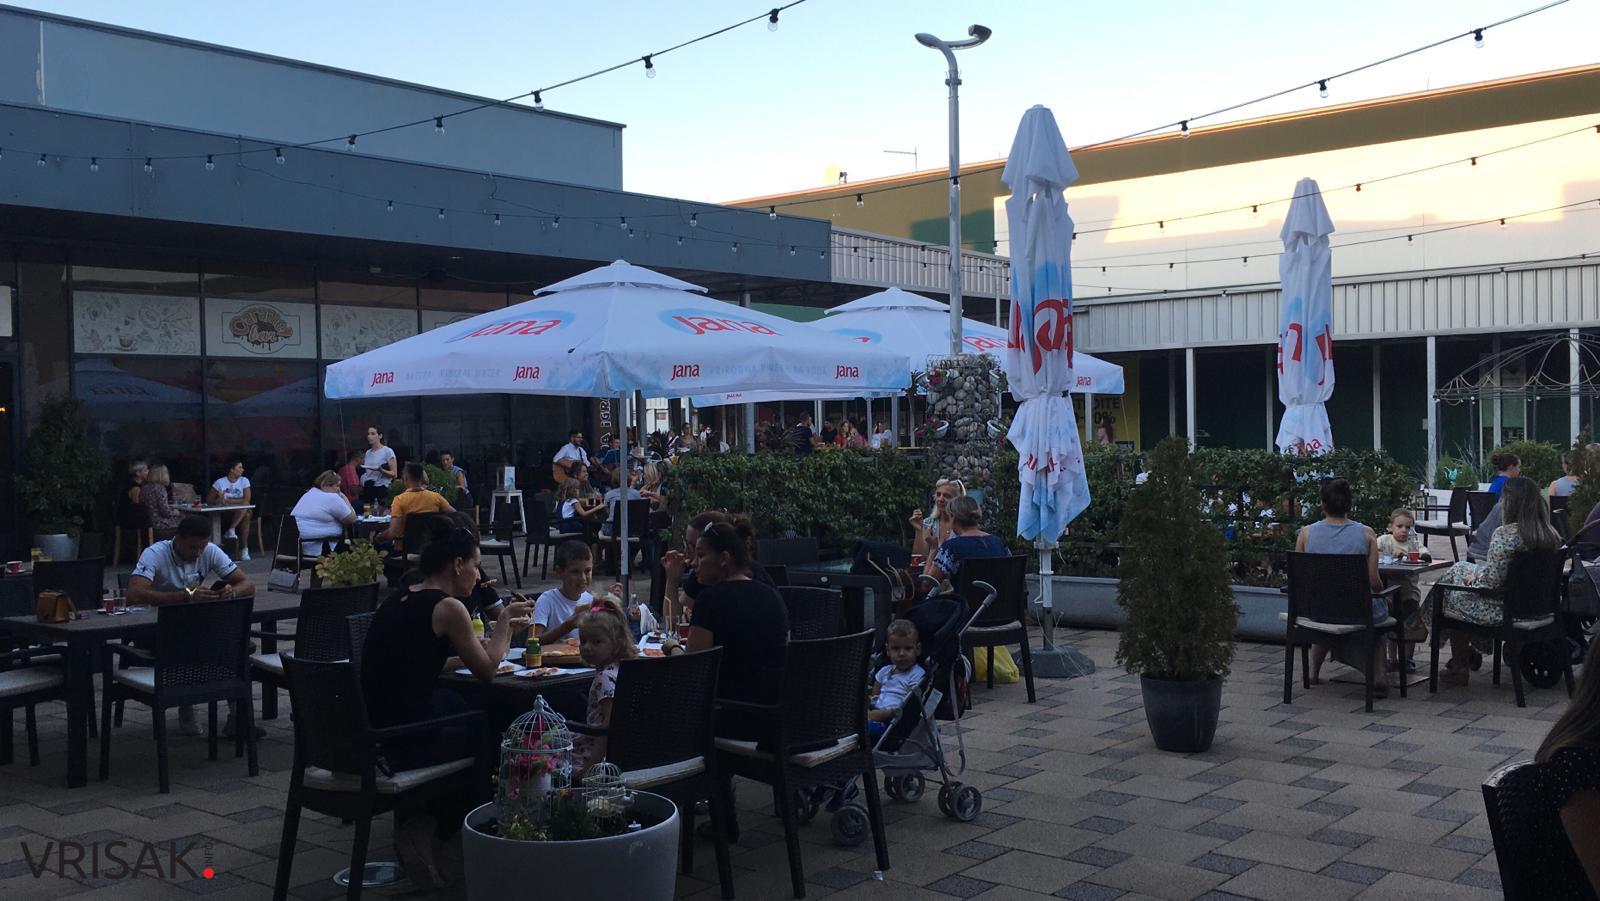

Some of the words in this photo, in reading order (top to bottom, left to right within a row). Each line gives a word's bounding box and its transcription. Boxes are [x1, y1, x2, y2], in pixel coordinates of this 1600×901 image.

[371, 371, 395, 387] Jana
[512, 365, 540, 382] Jana
[670, 363, 700, 381] Jana
[834, 364, 859, 380] Jana
